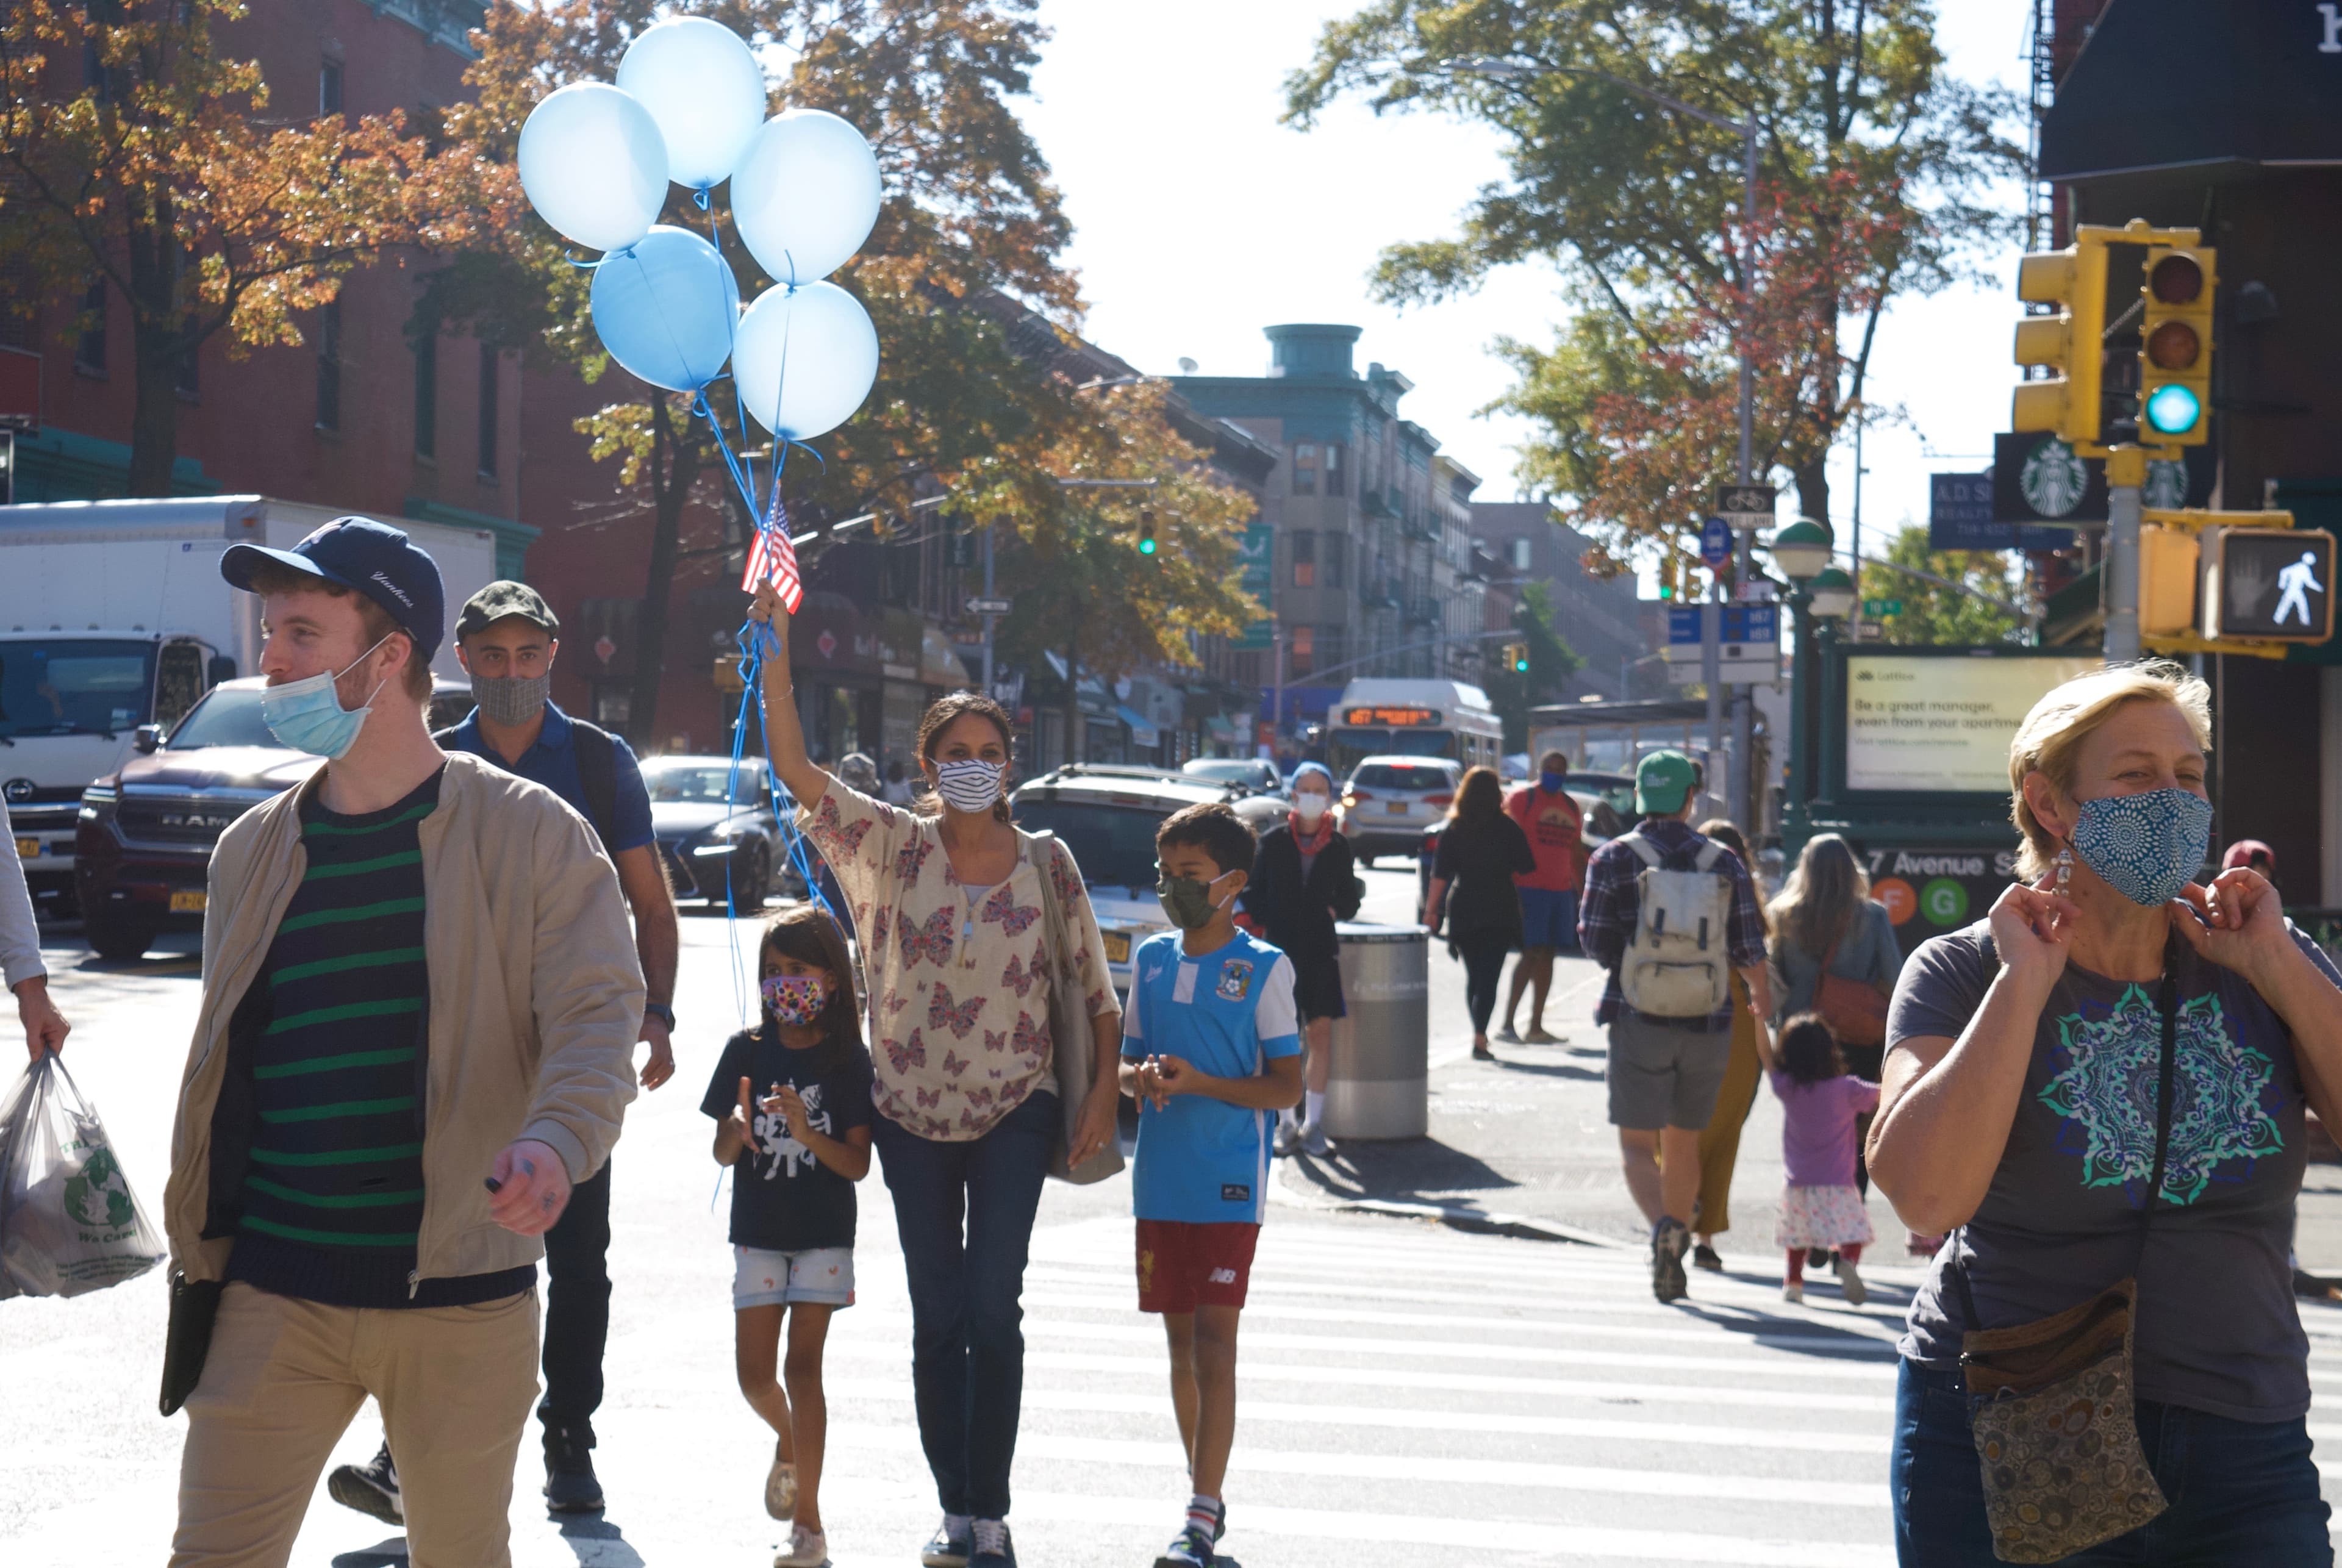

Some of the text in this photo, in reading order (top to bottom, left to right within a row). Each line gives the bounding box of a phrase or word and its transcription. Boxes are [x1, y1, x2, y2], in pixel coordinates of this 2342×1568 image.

[369, 571, 415, 609] Yankees
[1877, 671, 1915, 681] Lattice
[1855, 701, 1872, 712] Be
[1876, 703, 1885, 712] a
[1889, 701, 1924, 714] great
[1855, 718, 1887, 728] even
[1891, 717, 1922, 728] from
[1927, 718, 1958, 730] your
[162, 814, 231, 828] RAM
[1868, 851, 2019, 877] 7 Avenue S
[1883, 889, 1957, 914] F G
[78, 1229, 136, 1244] We Care
